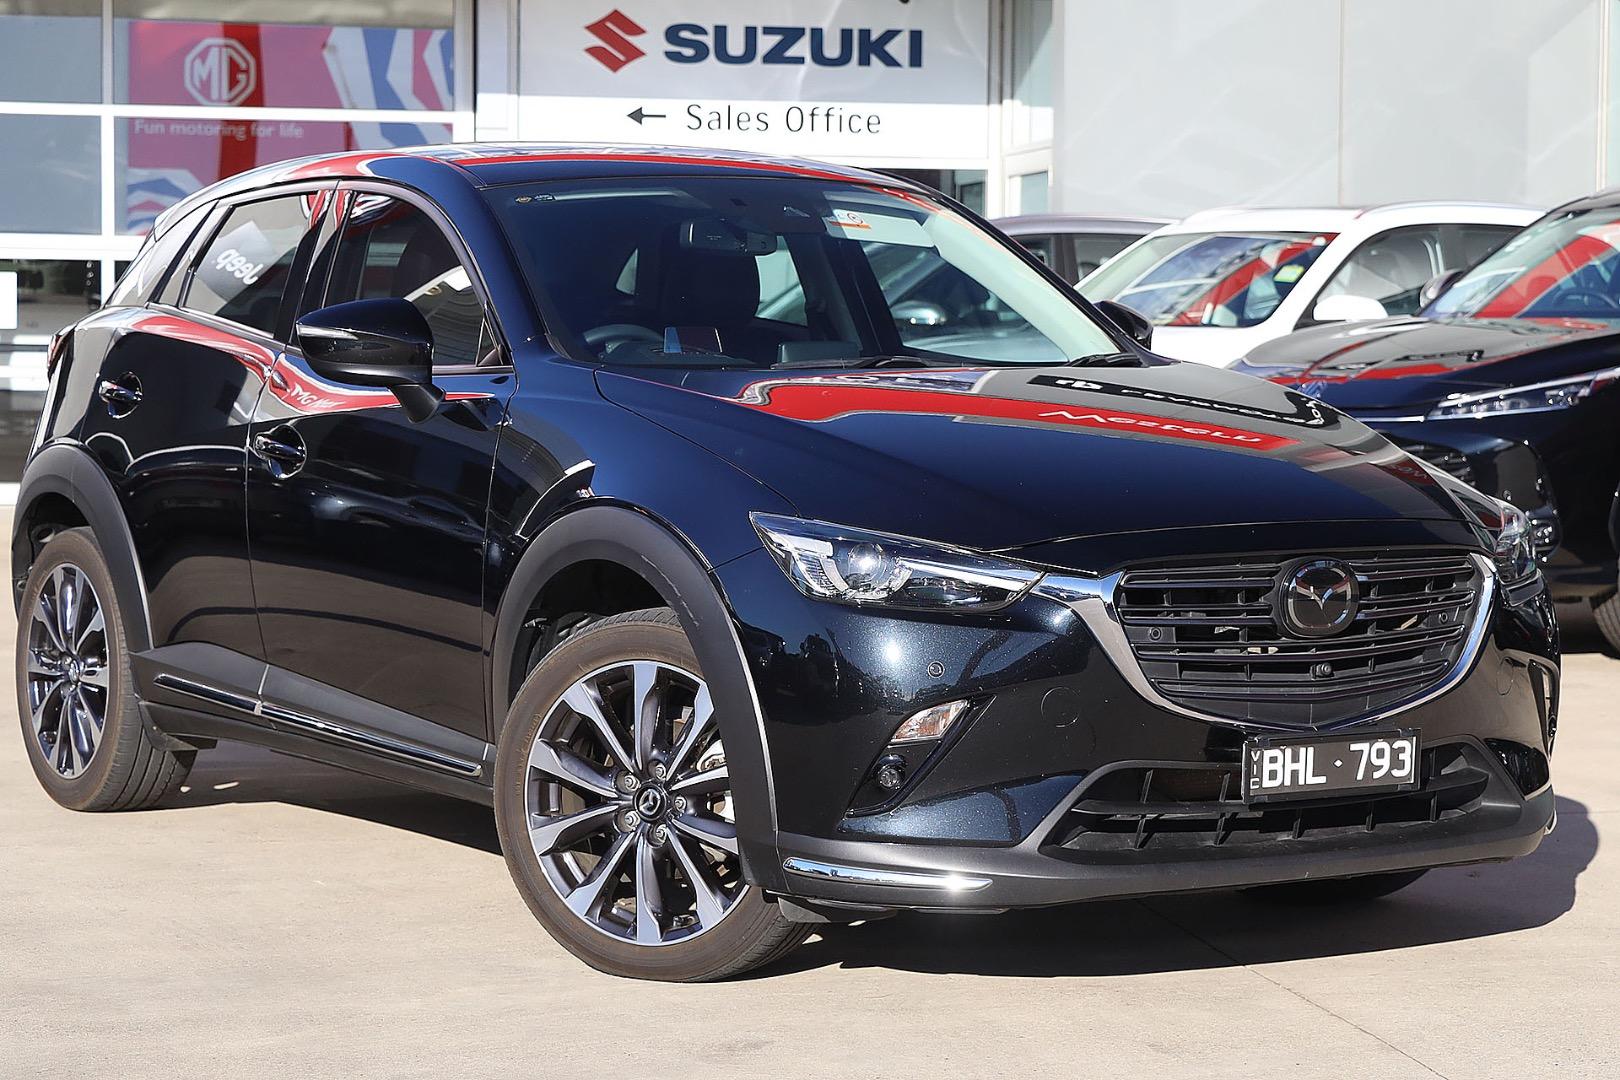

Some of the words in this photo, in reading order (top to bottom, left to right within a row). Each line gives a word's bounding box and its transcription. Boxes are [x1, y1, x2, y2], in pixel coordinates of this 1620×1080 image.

[663, 23, 923, 68] SUZUKI
[192, 47, 248, 100] MG
[134, 119, 166, 136] Fun
[170, 121, 247, 141] motoring
[252, 122, 275, 138] for
[279, 122, 304, 139] life
[686, 104, 769, 132] Sales
[785, 105, 882, 134] Office
[1250, 750, 1261, 789] VIC
[1261, 746, 1327, 788] BHL
[1349, 739, 1412, 781] 793
